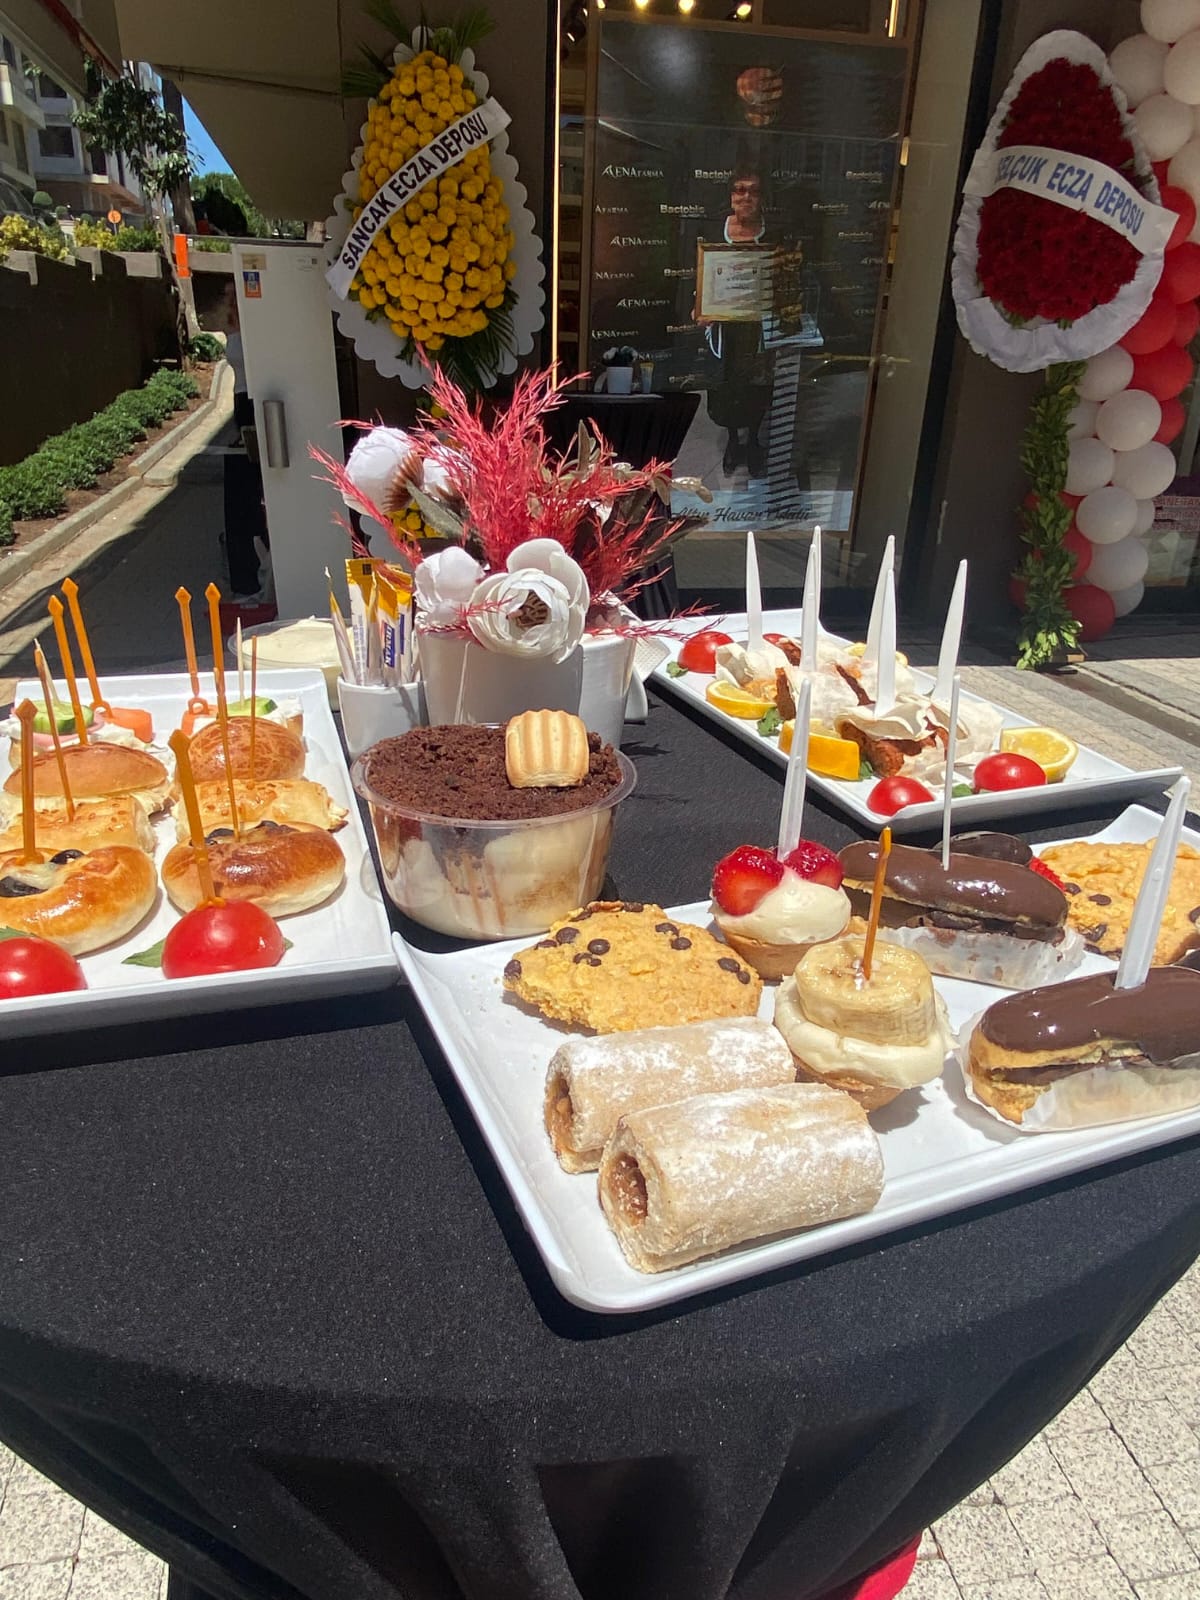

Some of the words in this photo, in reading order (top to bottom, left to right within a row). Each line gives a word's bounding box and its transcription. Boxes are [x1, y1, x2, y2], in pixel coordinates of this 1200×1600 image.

[342, 192, 396, 270] SANCAK
[388, 156, 438, 199] ECZA
[429, 112, 488, 164] DEPOSU
[994, 154, 1048, 185] ELÇUK
[1046, 162, 1094, 202] ECZA
[1094, 180, 1145, 235] DEPOSU
